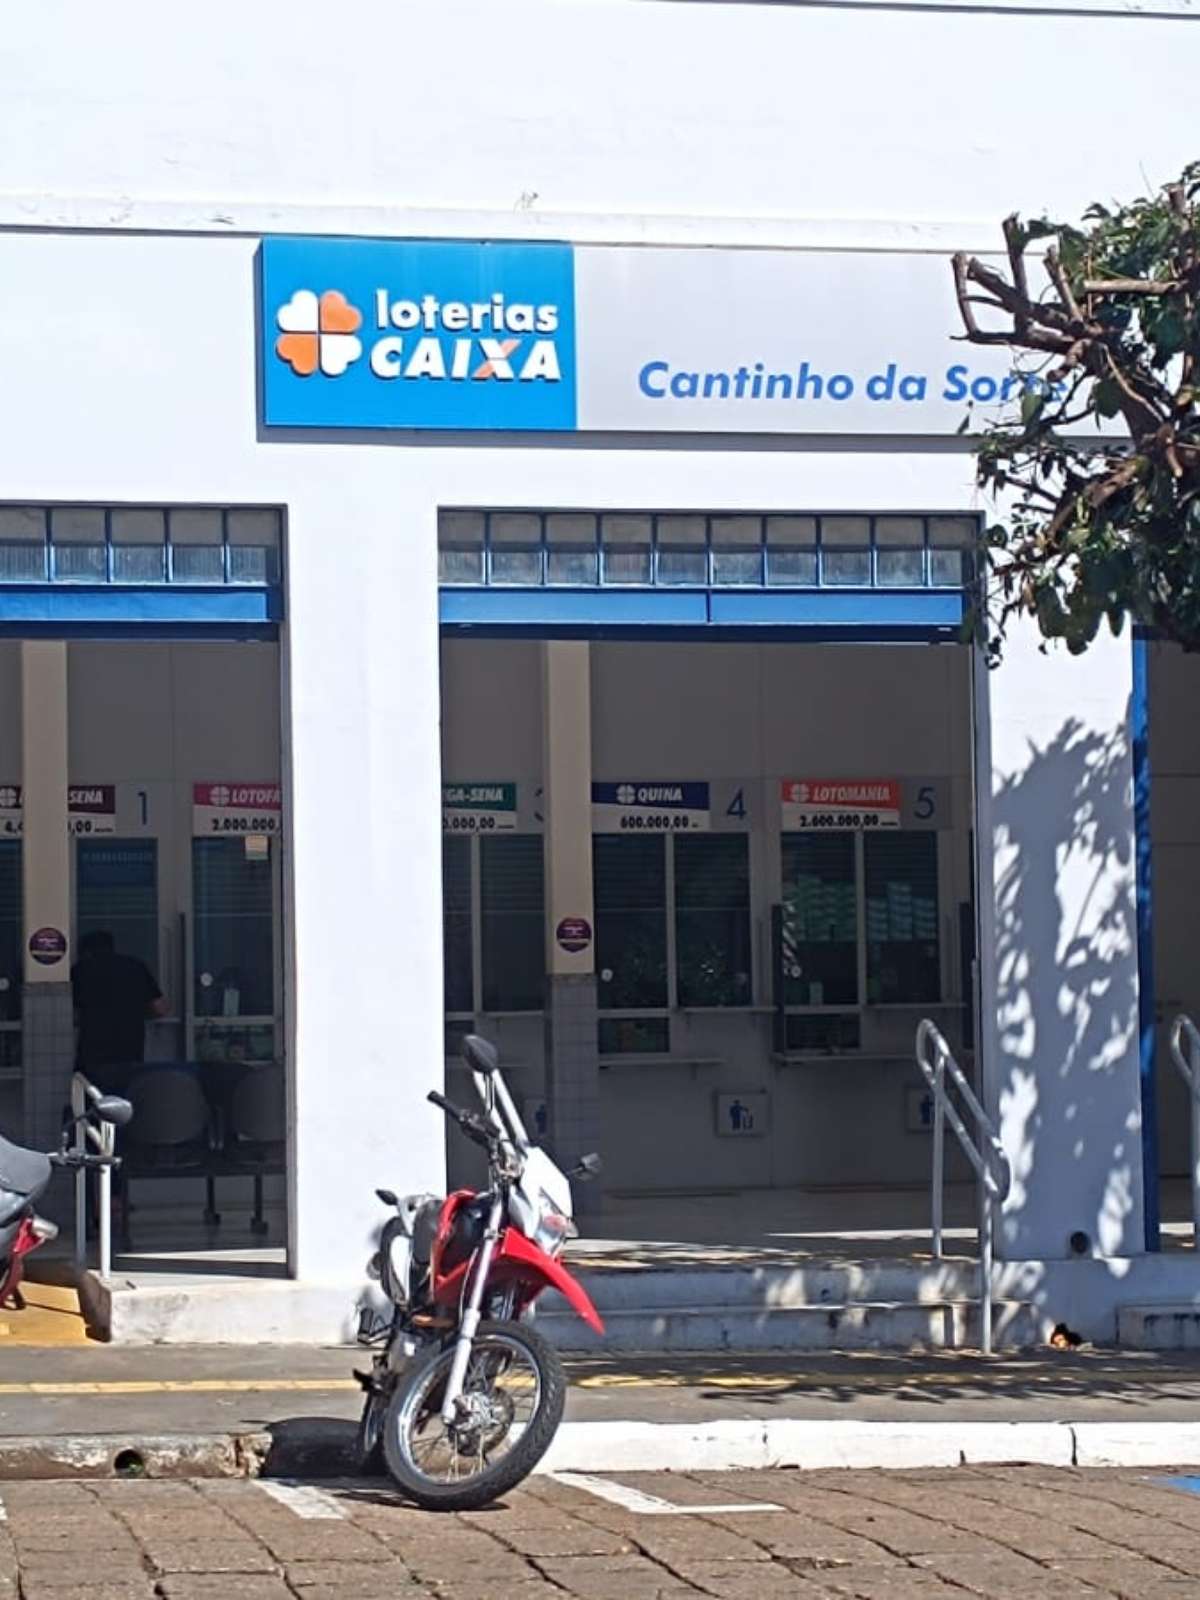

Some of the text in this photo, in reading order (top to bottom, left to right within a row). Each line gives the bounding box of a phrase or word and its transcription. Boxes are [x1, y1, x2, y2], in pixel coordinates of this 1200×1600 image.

[375, 288, 559, 331] loterias
[370, 336, 562, 380] CAIXA
[638, 361, 855, 400] Cantinho
[866, 363, 927, 401] da
[637, 786, 683, 803] QUINA
[727, 788, 747, 821] 4
[812, 785, 891, 802] LOTOMANIA
[914, 787, 935, 820] 5
